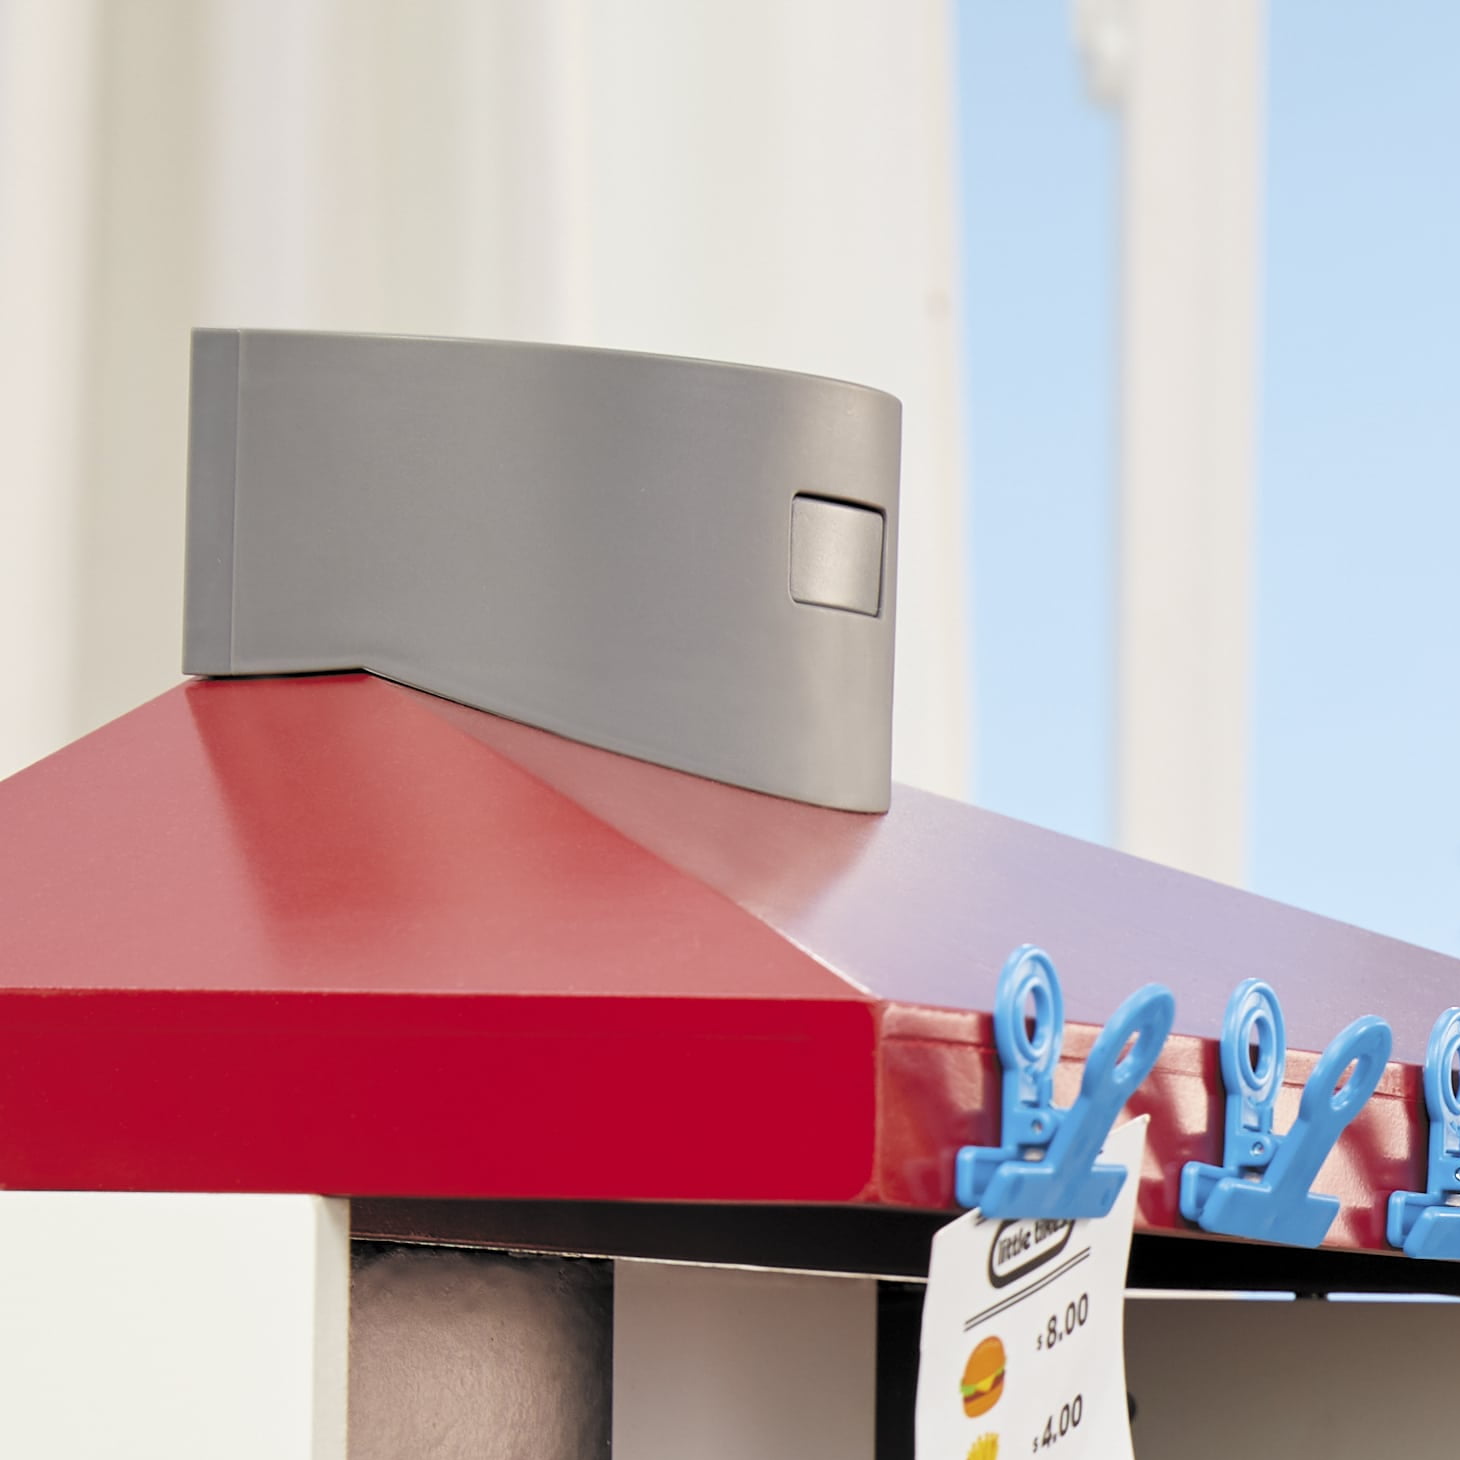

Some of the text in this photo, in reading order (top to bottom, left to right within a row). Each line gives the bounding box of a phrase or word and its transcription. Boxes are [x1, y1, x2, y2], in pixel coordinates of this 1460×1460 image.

[997, 1227, 1031, 1266] little
[1036, 1292, 1089, 1351] $8.00
[1032, 1393, 1083, 1454] $4.00
